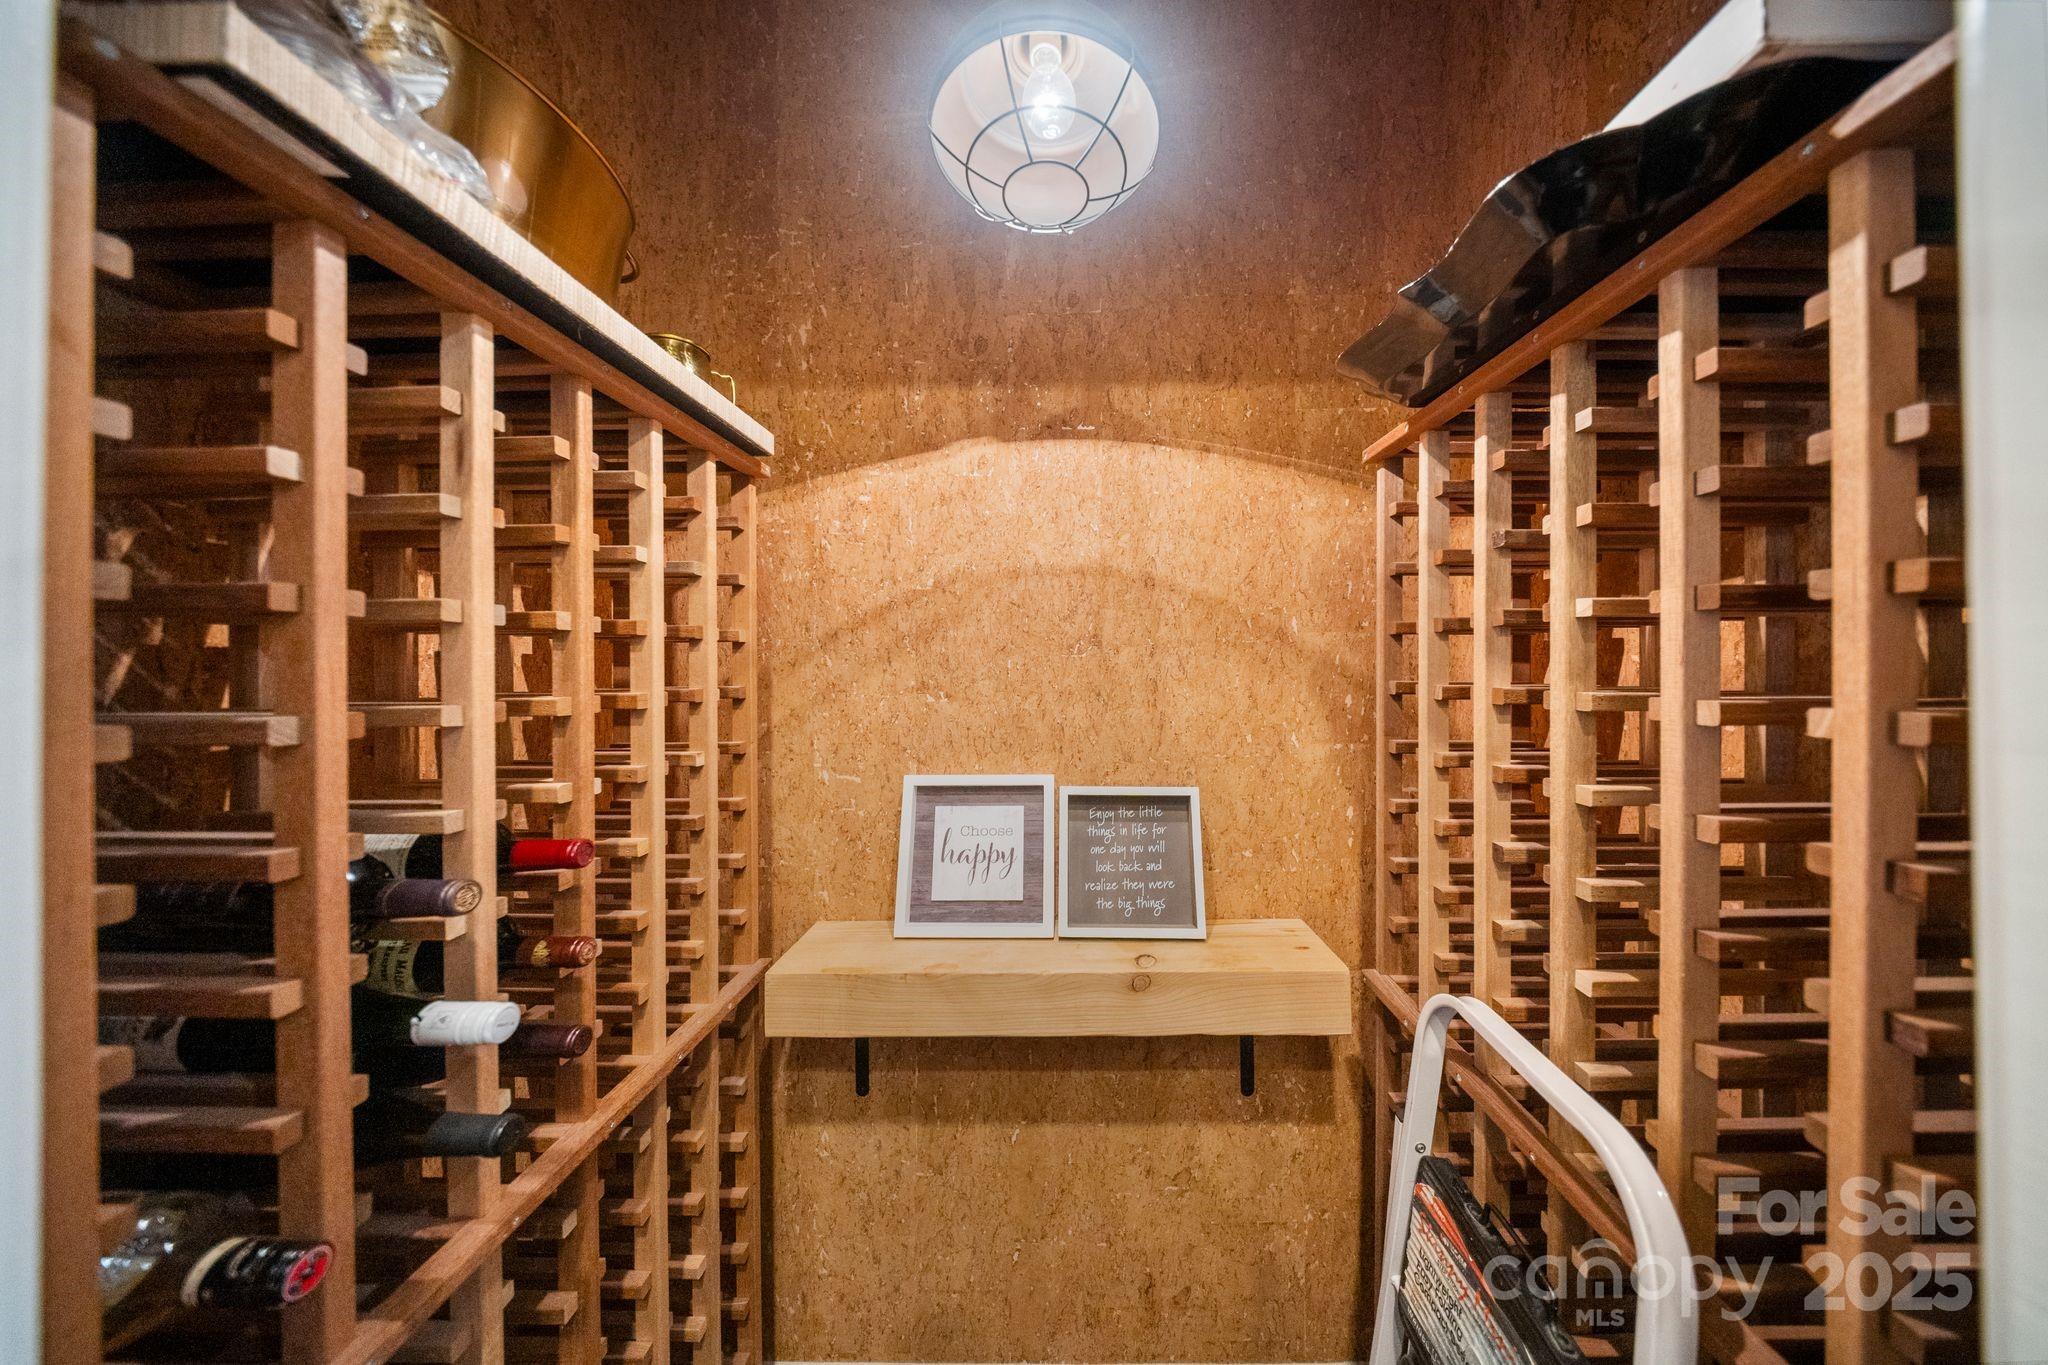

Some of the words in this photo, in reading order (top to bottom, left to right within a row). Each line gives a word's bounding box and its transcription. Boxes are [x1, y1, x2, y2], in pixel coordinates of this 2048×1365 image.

[1089, 806, 1115, 827] Enjoy
[1118, 806, 1135, 818] the
[1139, 805, 1163, 818] little
[960, 825, 1014, 837] Choose
[1088, 825, 1115, 844] things
[1120, 824, 1127, 836] in
[1132, 823, 1148, 839] life
[1152, 823, 1167, 839] for
[941, 827, 1017, 886] happy
[1090, 846, 1105, 854] one
[1110, 842, 1126, 860] day
[1131, 845, 1144, 860] you
[1148, 840, 1165, 853] will
[1096, 860, 1116, 872] look
[1119, 860, 1143, 872] back
[1146, 859, 1162, 871] and
[1085, 878, 1118, 891] realize
[1122, 878, 1144, 896] they
[1149, 880, 1175, 889] were
[1096, 897, 1114, 909] the
[1118, 896, 1135, 917] big
[1136, 895, 1167, 916] things
